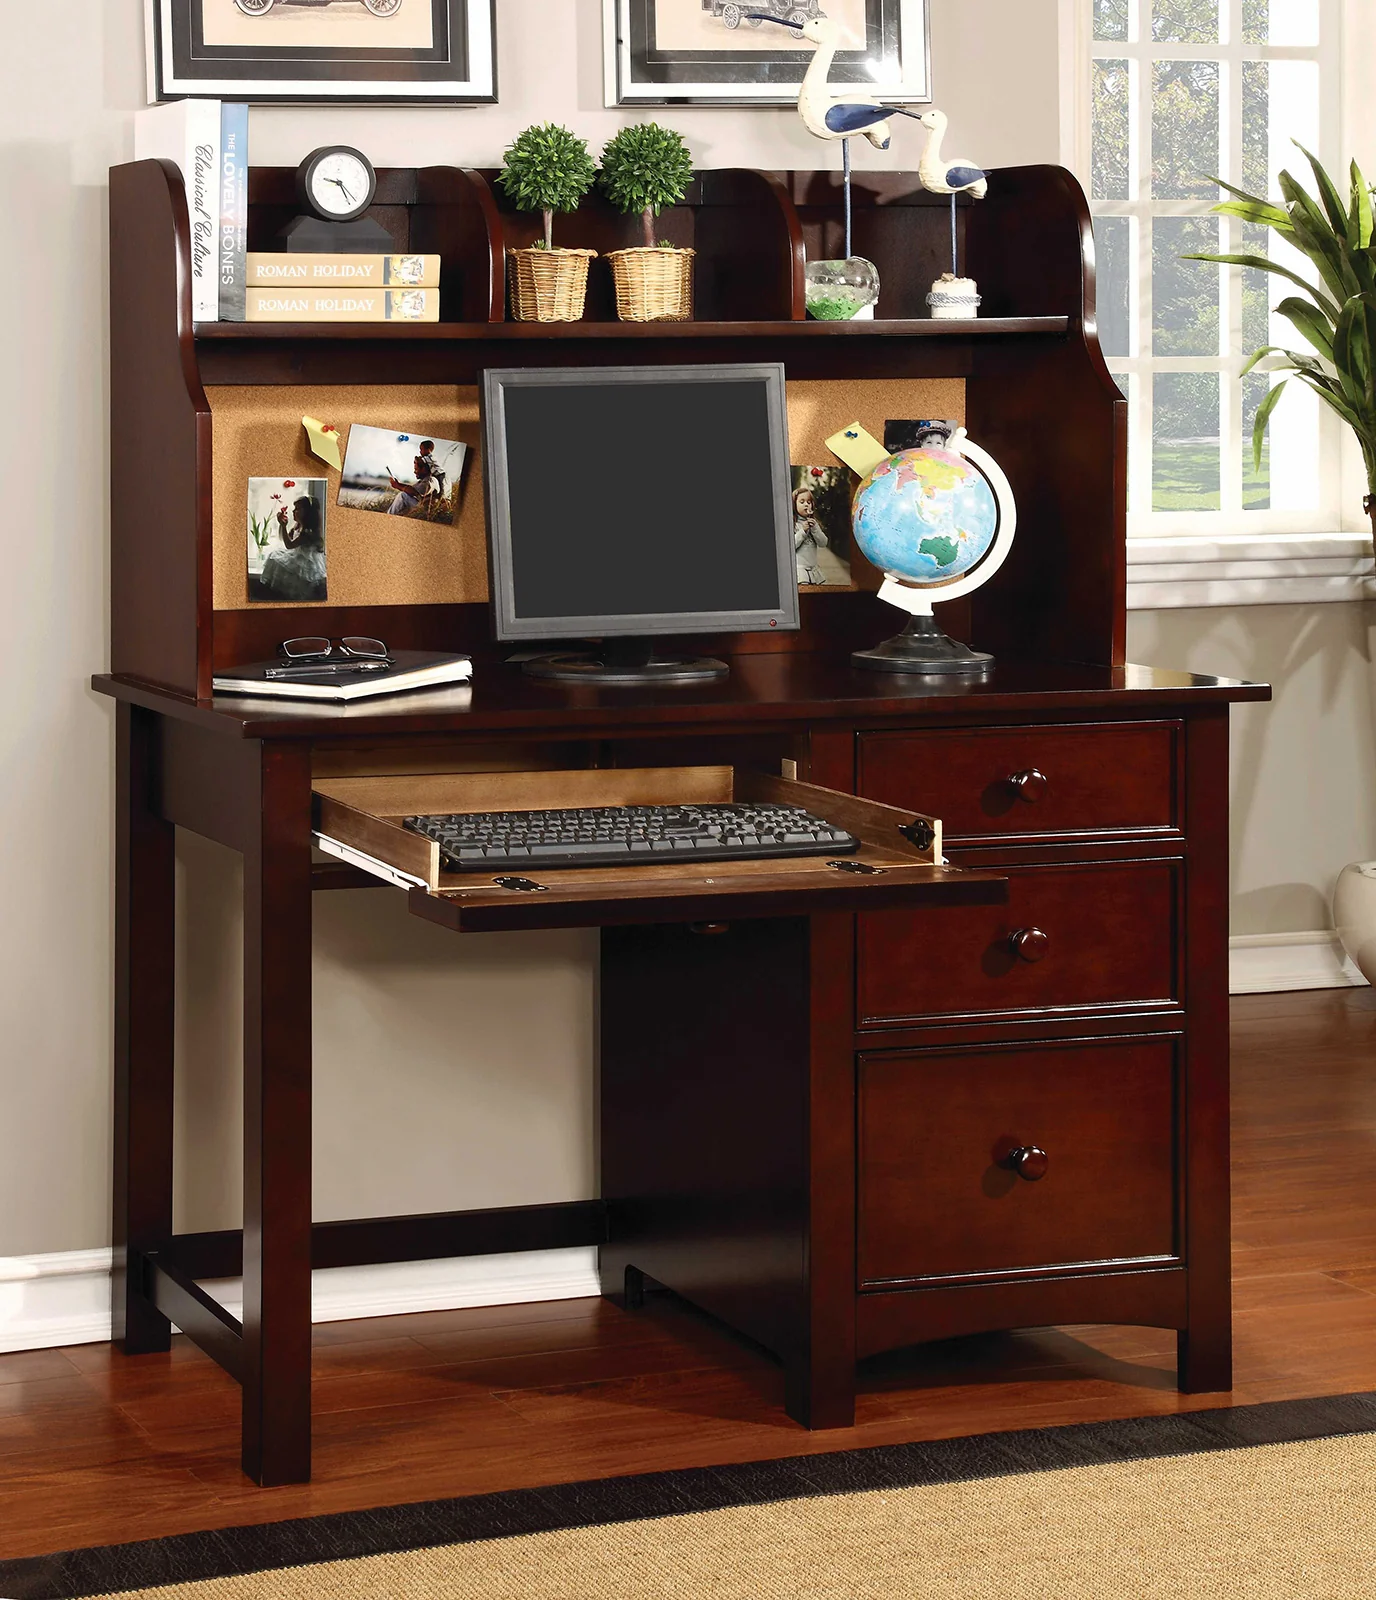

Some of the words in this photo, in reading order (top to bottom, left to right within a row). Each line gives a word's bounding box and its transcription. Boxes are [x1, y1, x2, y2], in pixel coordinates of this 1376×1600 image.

[228, 133, 236, 150] THE
[194, 144, 213, 219] Classical
[223, 152, 236, 219] LOVELY
[194, 221, 212, 277] Culture
[222, 225, 235, 284] BONES
[256, 265, 308, 277] ROMAN
[313, 265, 374, 277] HOLIDAY
[258, 299, 309, 312] ROMAN
[315, 299, 375, 311] HOLIDAY
